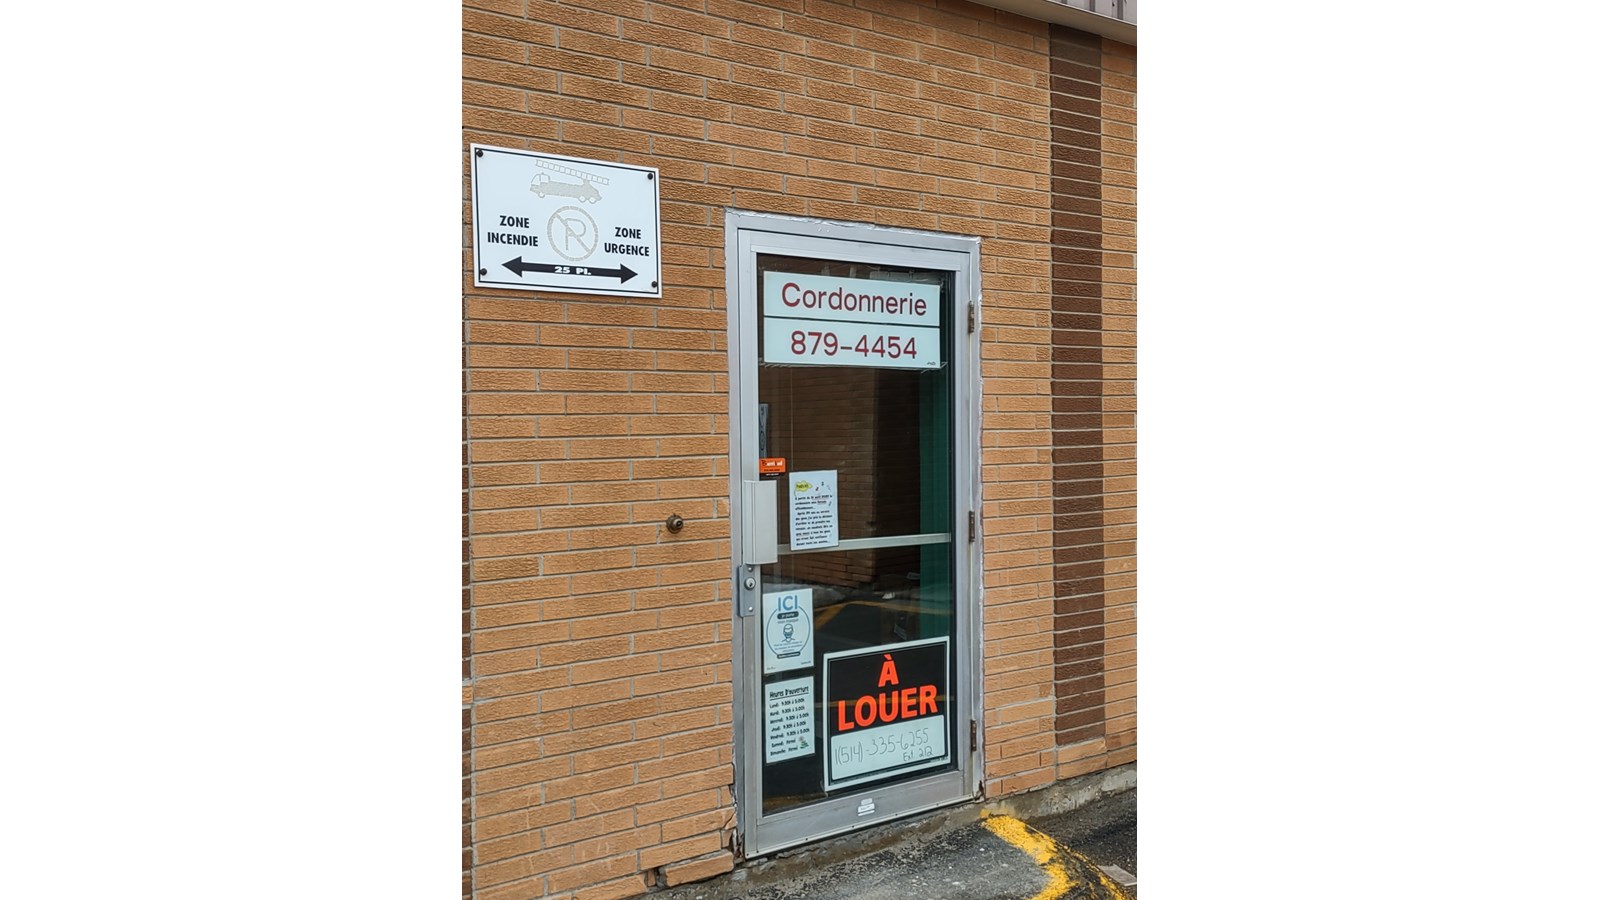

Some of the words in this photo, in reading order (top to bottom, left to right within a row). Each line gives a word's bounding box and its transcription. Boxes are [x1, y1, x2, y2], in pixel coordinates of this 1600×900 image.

[499, 215, 530, 228] ZONE
[487, 231, 539, 247] INCENDIE
[615, 226, 642, 239] ZONE
[604, 242, 650, 256] URGENCE
[554, 265, 571, 274] 25
[781, 282, 927, 316] Cordonnerie
[790, 330, 918, 359] 879-4454
[778, 595, 798, 611] ICI
[878, 654, 900, 687] À
[837, 684, 938, 732] LOUER
